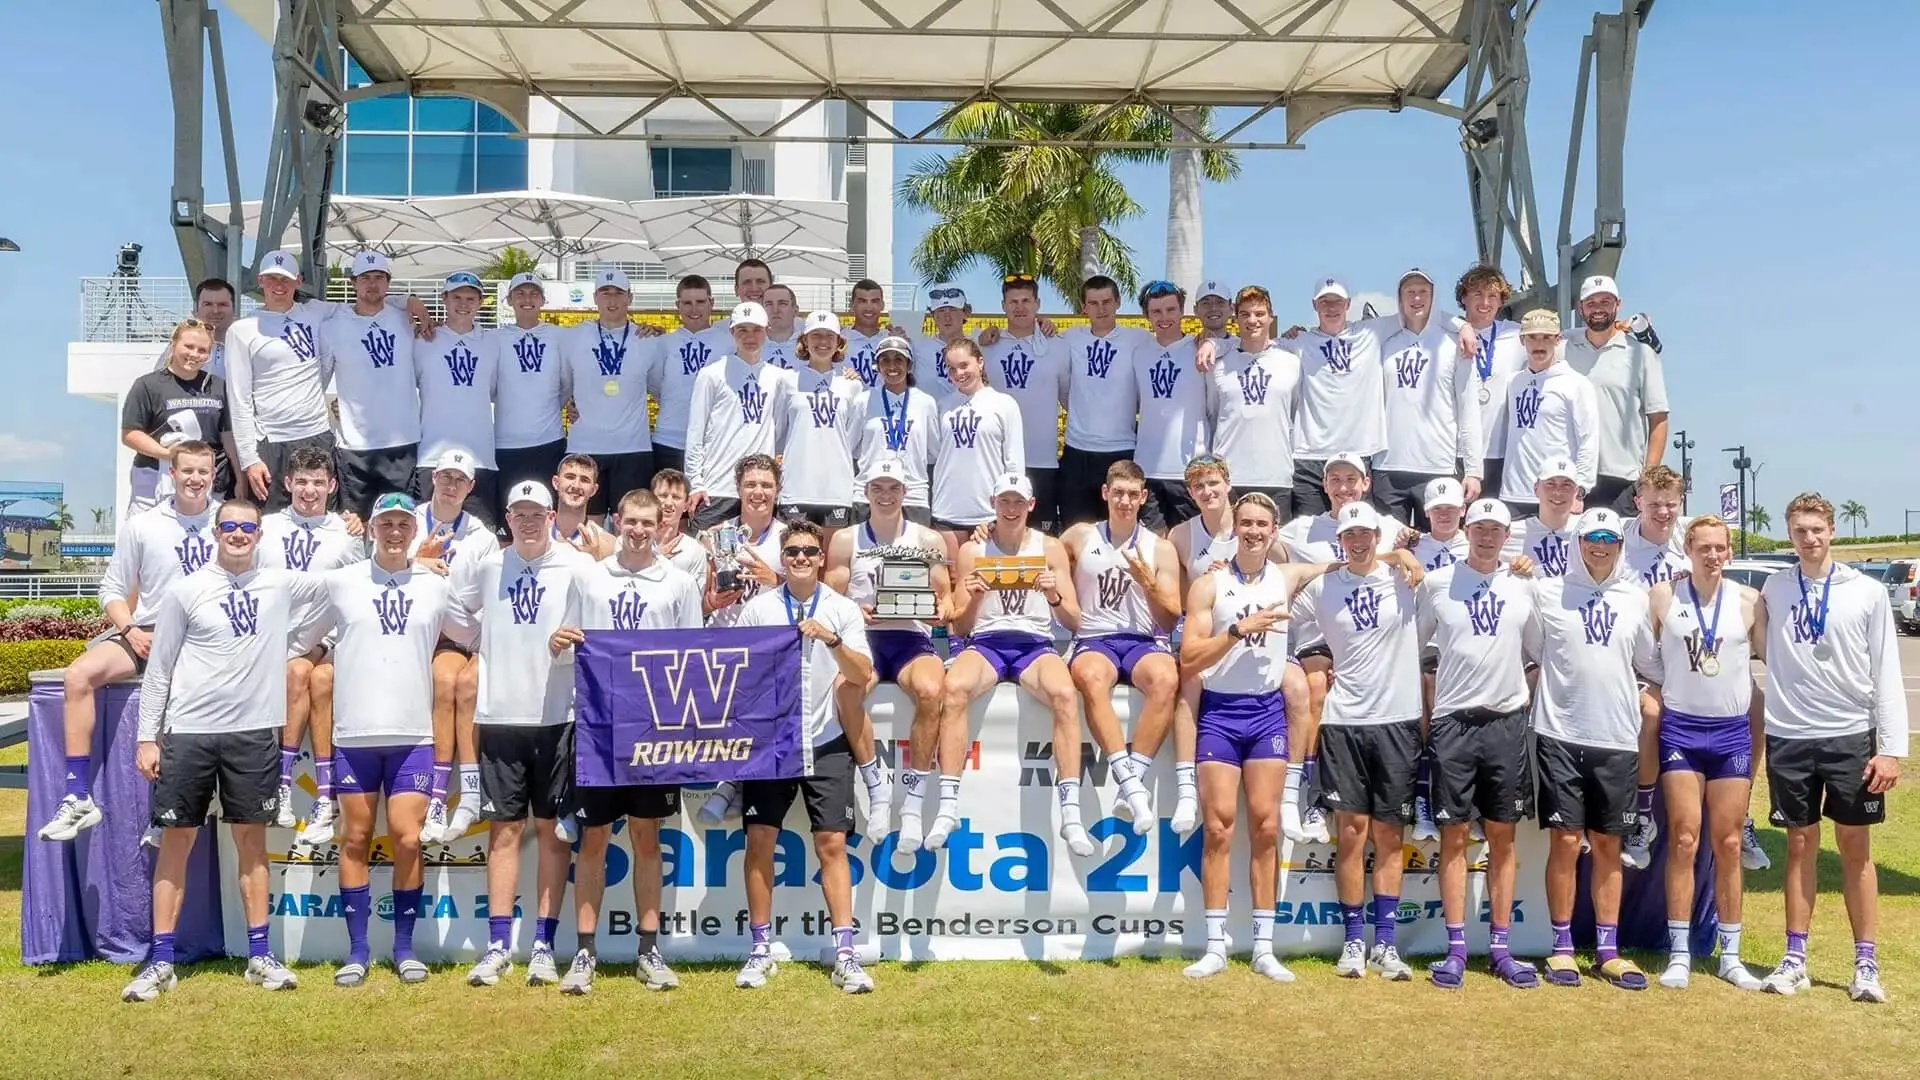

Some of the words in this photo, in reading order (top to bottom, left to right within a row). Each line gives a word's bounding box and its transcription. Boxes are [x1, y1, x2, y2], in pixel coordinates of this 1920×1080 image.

[631, 648, 749, 730] W
[630, 738, 753, 766] ROWING
[608, 909, 722, 936] Bttle
[734, 909, 788, 936] fr
[877, 912, 1077, 936] Benderson
[1092, 914, 1185, 938] Cups
